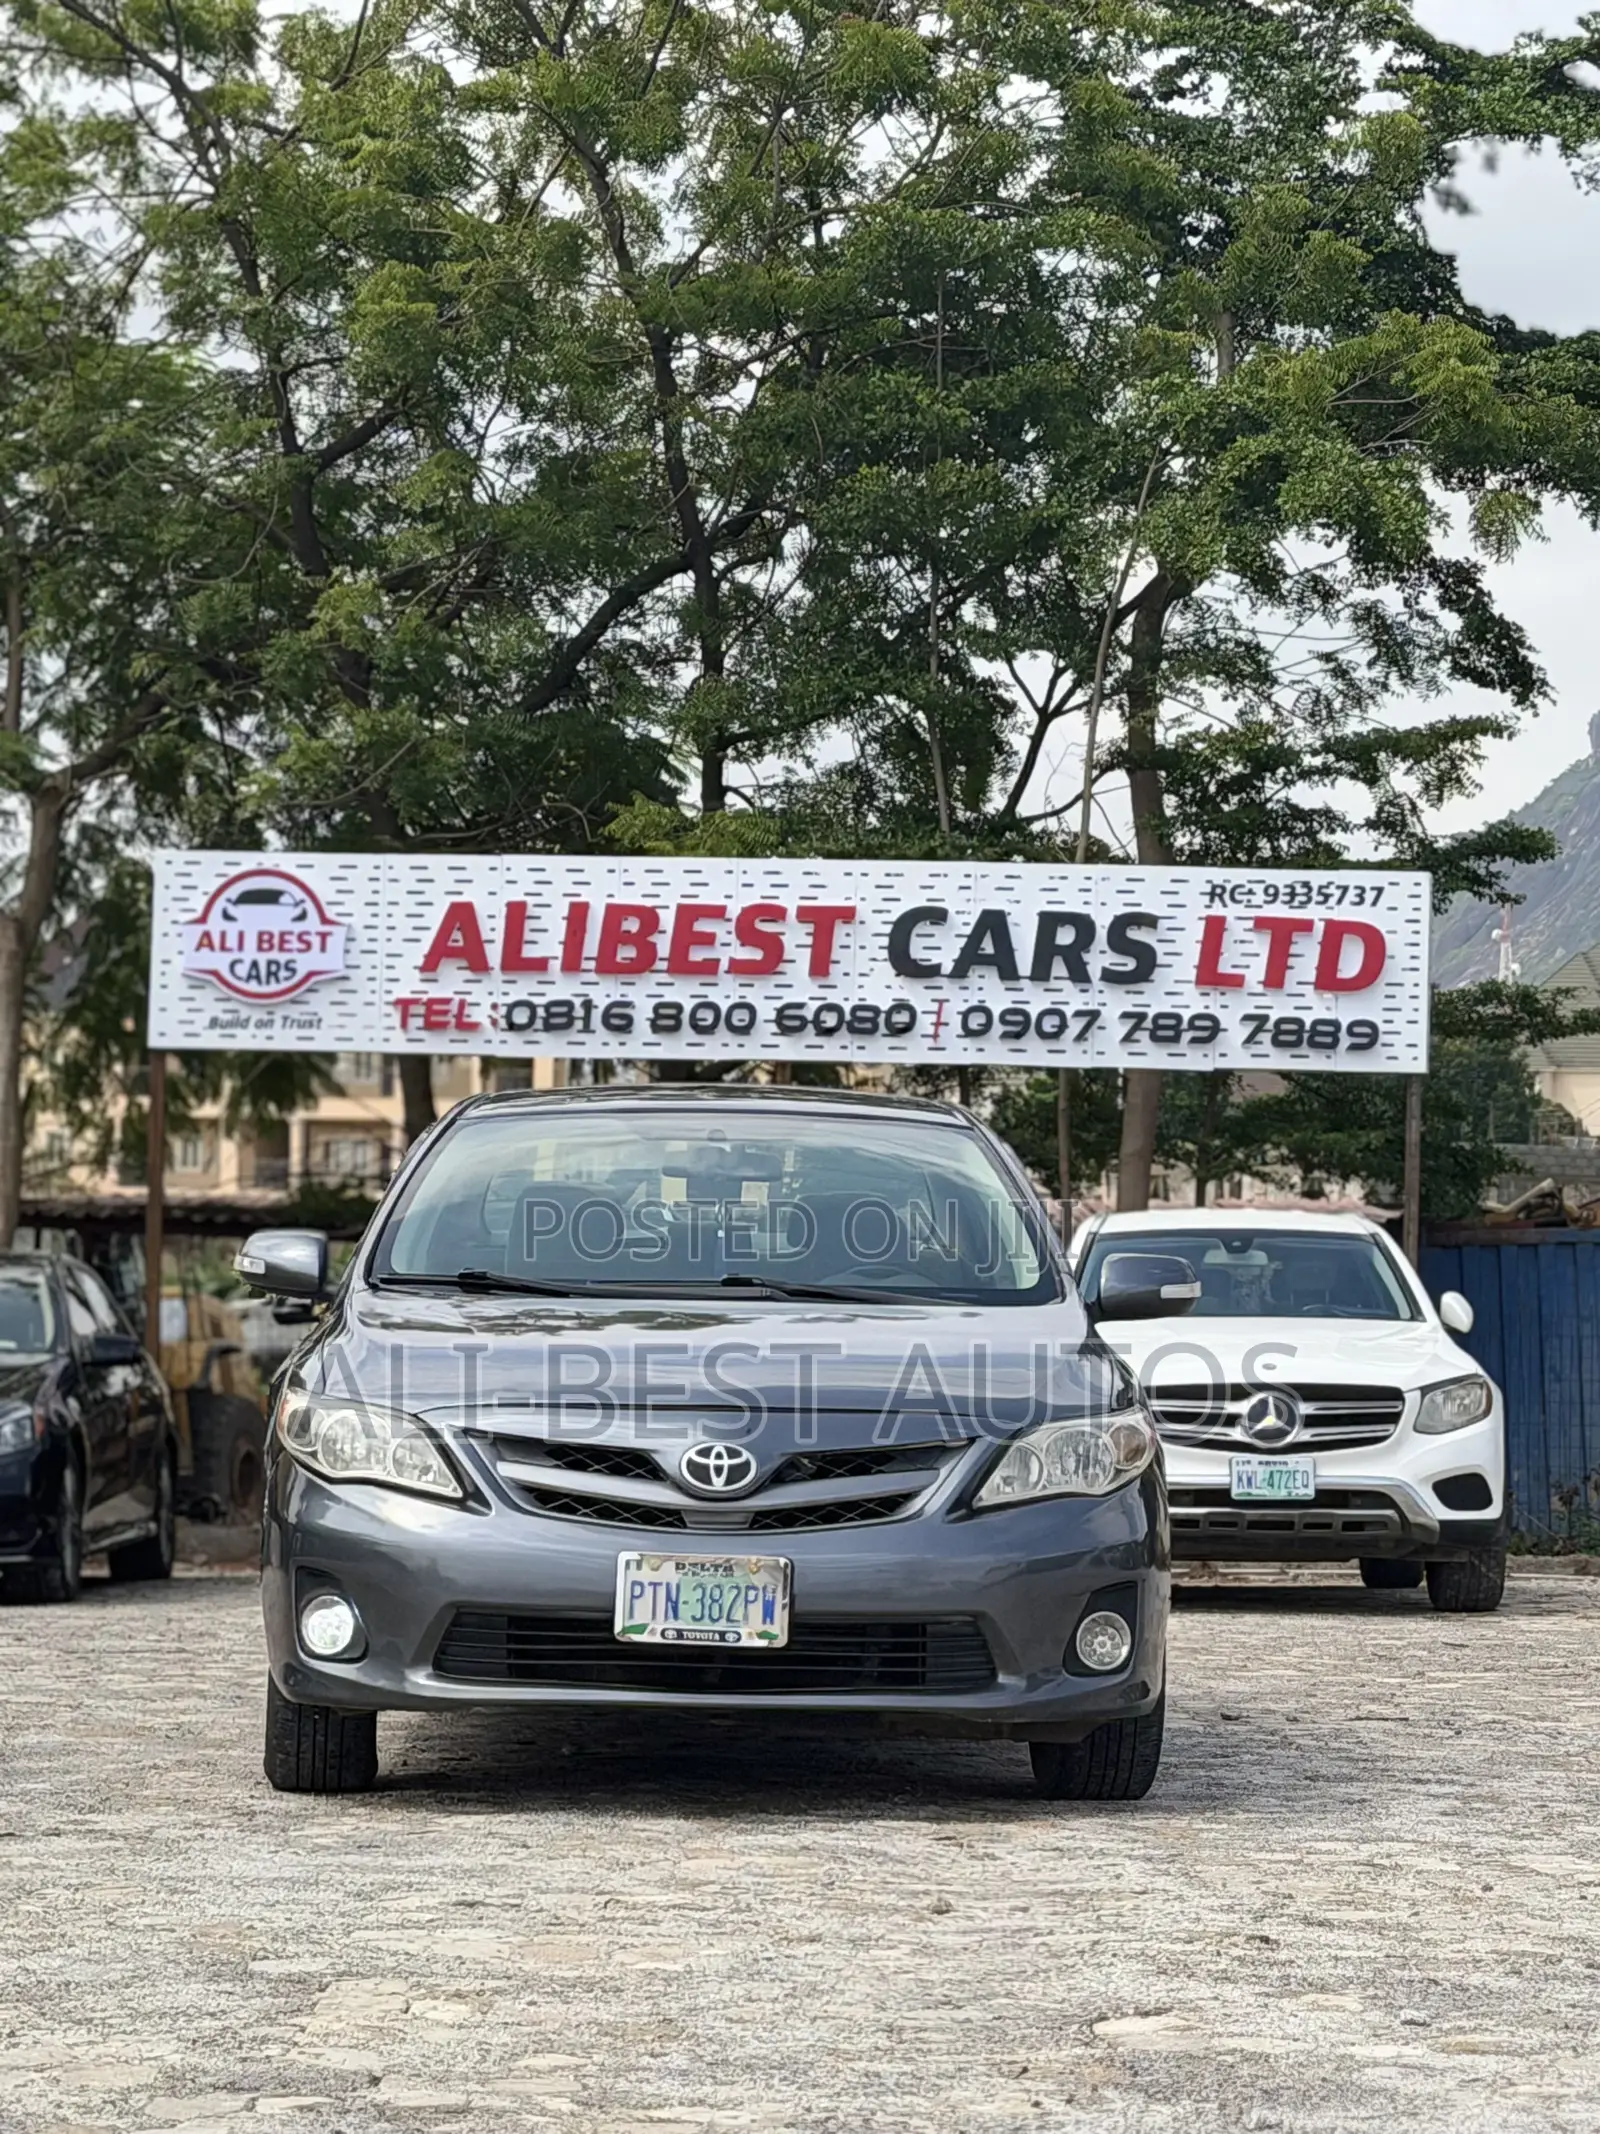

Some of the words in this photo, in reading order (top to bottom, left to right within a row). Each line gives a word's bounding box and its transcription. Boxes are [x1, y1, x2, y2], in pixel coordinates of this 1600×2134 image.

[1263, 884, 1385, 907] 9335737
[194, 930, 245, 953] ALI
[256, 930, 333, 954] BEST
[418, 899, 857, 979] ALIBEST
[887, 905, 1160, 985] CARS
[1194, 914, 1387, 993] LTD
[228, 958, 298, 985] CARS
[207, 1015, 253, 1030] Build
[254, 1018, 275, 1030] on
[281, 1014, 323, 1030] Trust
[505, 999, 636, 1035] 0816
[650, 1000, 758, 1036] 800
[774, 1001, 918, 1036] 6080
[961, 1004, 1101, 1043] 0907
[1118, 1011, 1221, 1046] 789
[1239, 1013, 1380, 1051] 7889
[682, 1631, 720, 1641] TOYOTA
